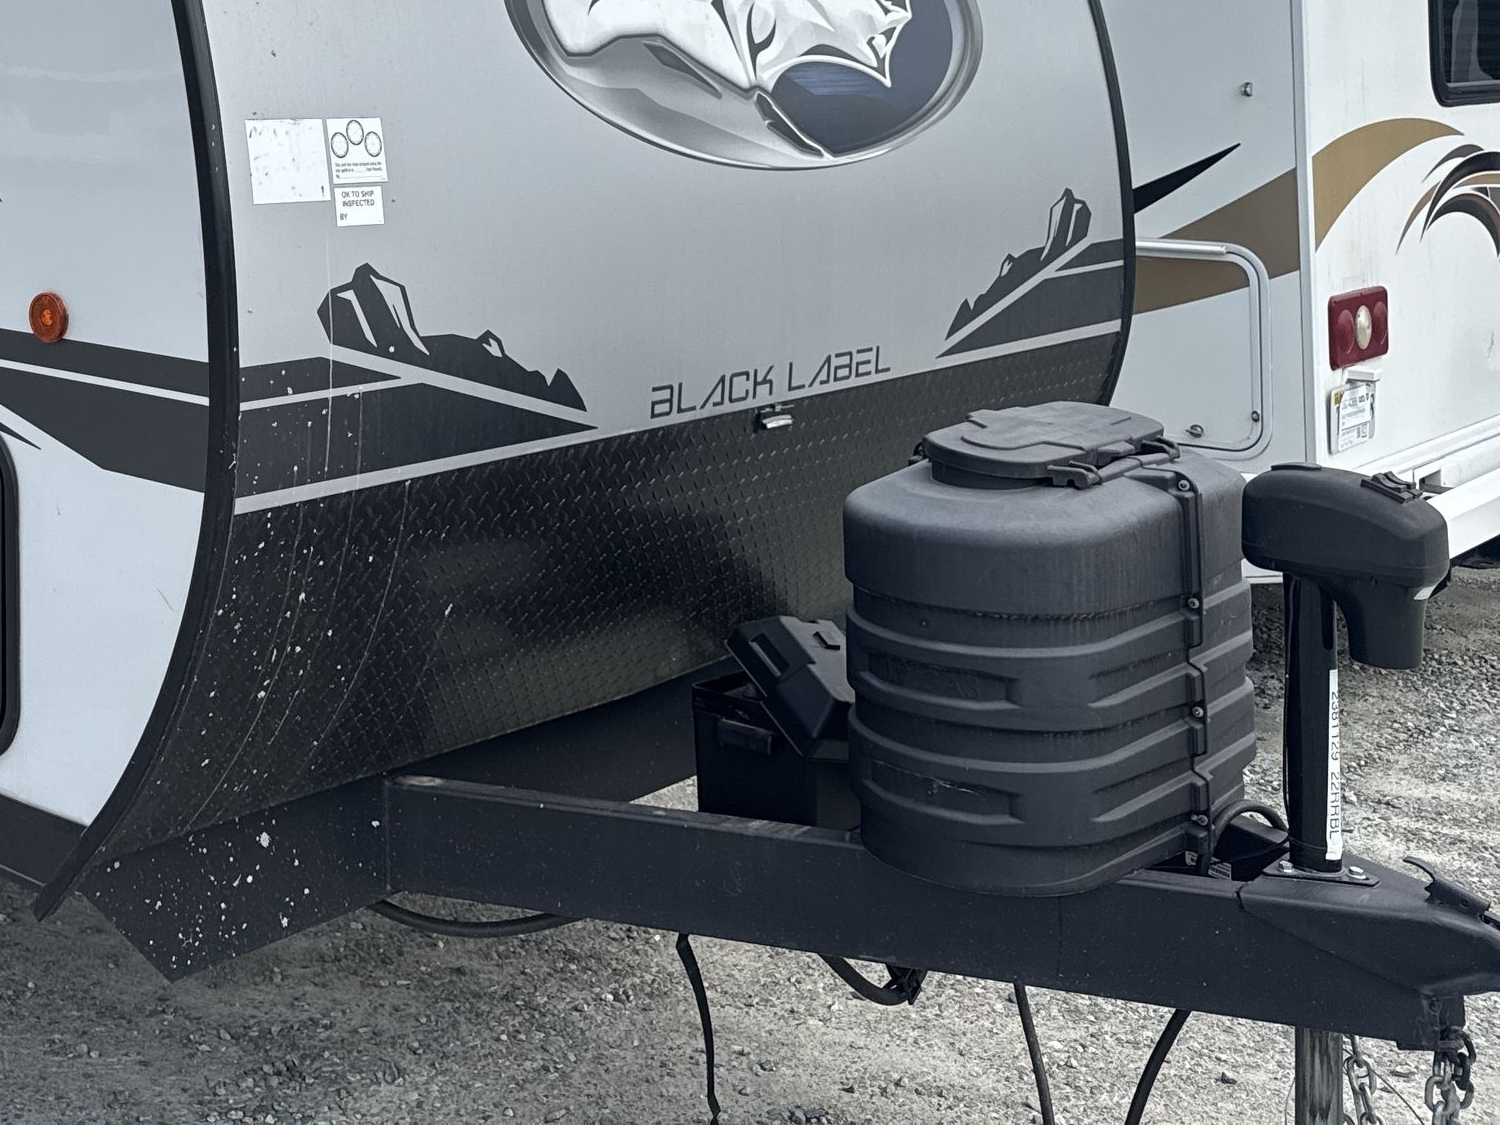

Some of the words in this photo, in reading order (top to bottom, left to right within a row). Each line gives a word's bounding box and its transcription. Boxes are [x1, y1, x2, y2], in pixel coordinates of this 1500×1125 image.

[341, 190, 350, 199] OK
[351, 190, 360, 198] TO
[342, 199, 375, 207] INSPECTED
[340, 213, 348, 221] BY
[650, 365, 775, 420] BLACK
[788, 346, 891, 392] LABEL
[1331, 691, 1339, 761] 2381129
